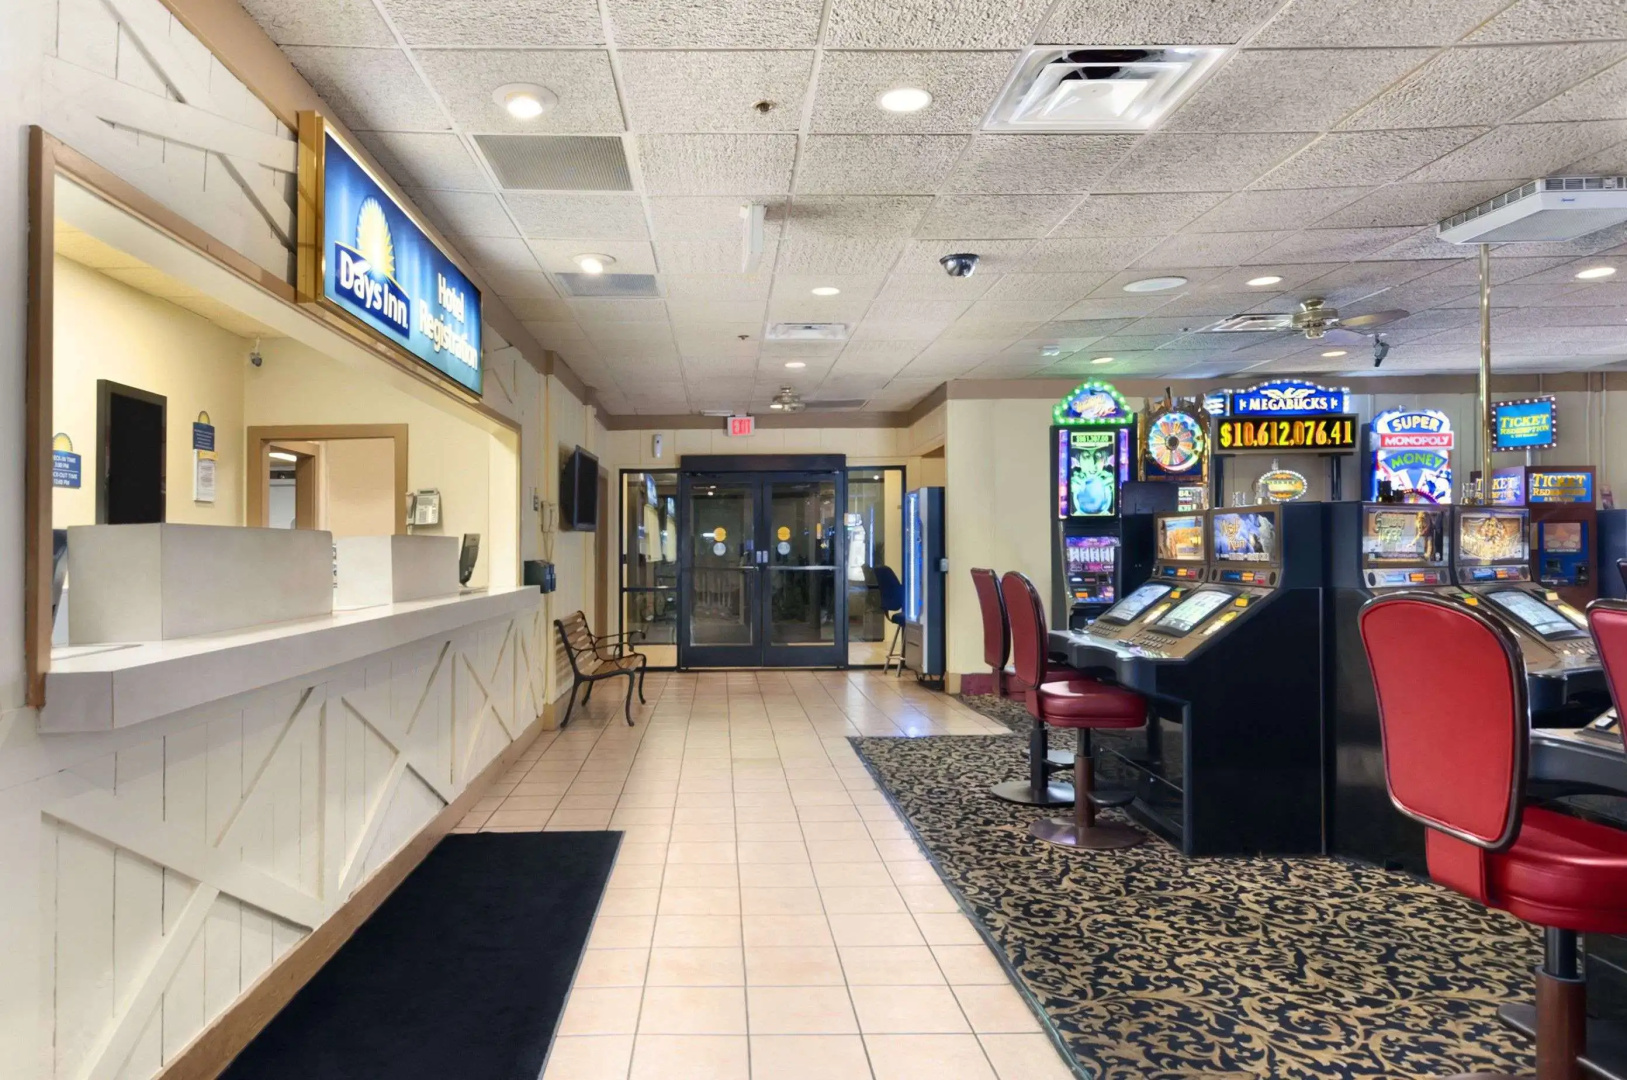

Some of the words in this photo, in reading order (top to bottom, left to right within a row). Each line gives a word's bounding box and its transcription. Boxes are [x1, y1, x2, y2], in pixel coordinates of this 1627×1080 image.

[340, 249, 383, 310] Days
[438, 272, 465, 324] Hotel
[419, 298, 478, 371] Registration
[1249, 398, 1328, 411] MEGABUCKS
[732, 419, 751, 435] EXIT
[1392, 416, 1440, 431] SUPER
[1500, 413, 1549, 428] TICKET
[1384, 436, 1450, 446] MONOPOLY
[1391, 453, 1444, 469] MONEY
